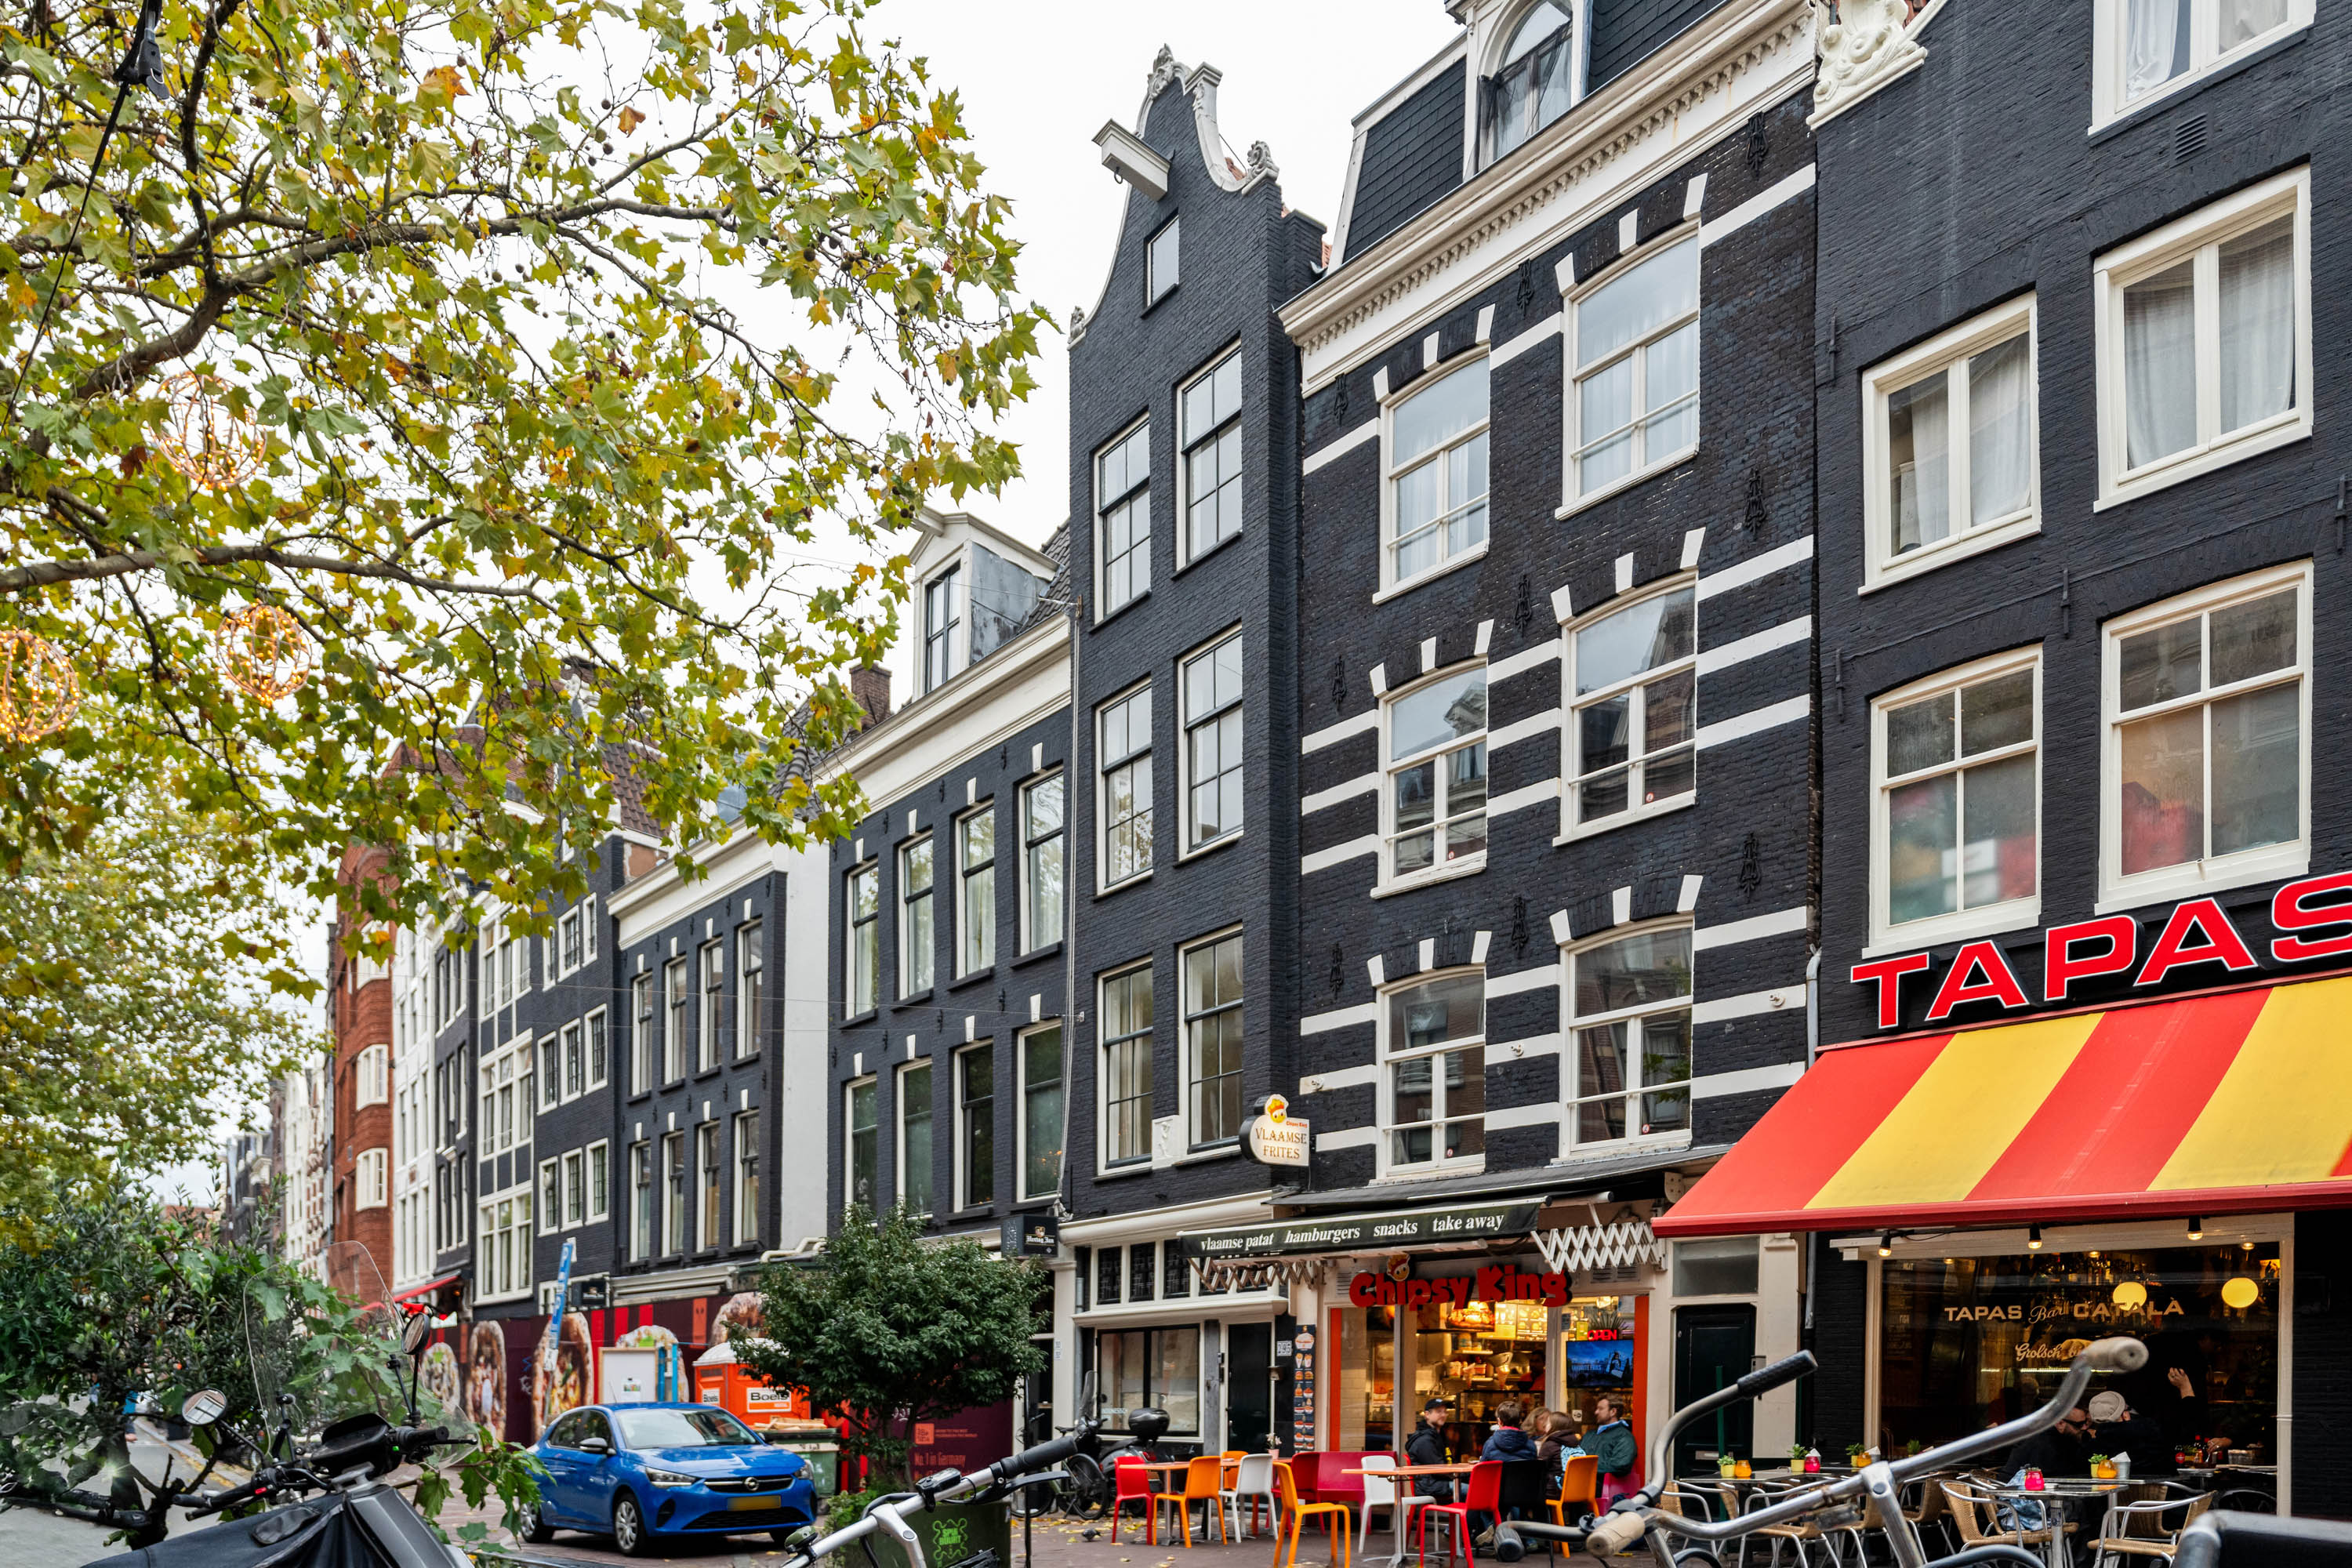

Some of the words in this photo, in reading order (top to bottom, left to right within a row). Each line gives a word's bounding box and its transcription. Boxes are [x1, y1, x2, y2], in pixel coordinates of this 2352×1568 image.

[1850, 870, 2352, 1029] TAPAS
[1255, 1127, 1307, 1145] VLAAMSE
[1263, 1144, 1300, 1160] FRITES
[1201, 1236, 1243, 1250] vlaamse
[1245, 1232, 1275, 1251] patat
[1283, 1227, 1361, 1243] hamburgers
[1373, 1219, 1418, 1237] snacks
[1432, 1215, 1463, 1232] take
[1465, 1214, 1504, 1231] away
[1349, 1271, 1471, 1312] Chipsy
[1477, 1264, 1570, 1308] King
[1944, 1305, 2023, 1322] TAPAS
[2027, 1305, 2068, 1324] Bar
[2073, 1297, 2185, 1319] CATALÀ
[1588, 1329, 1617, 1341] OPEN
[2014, 1342, 2063, 1362] Grolsch
[703, 1394, 719, 1403] Boels
